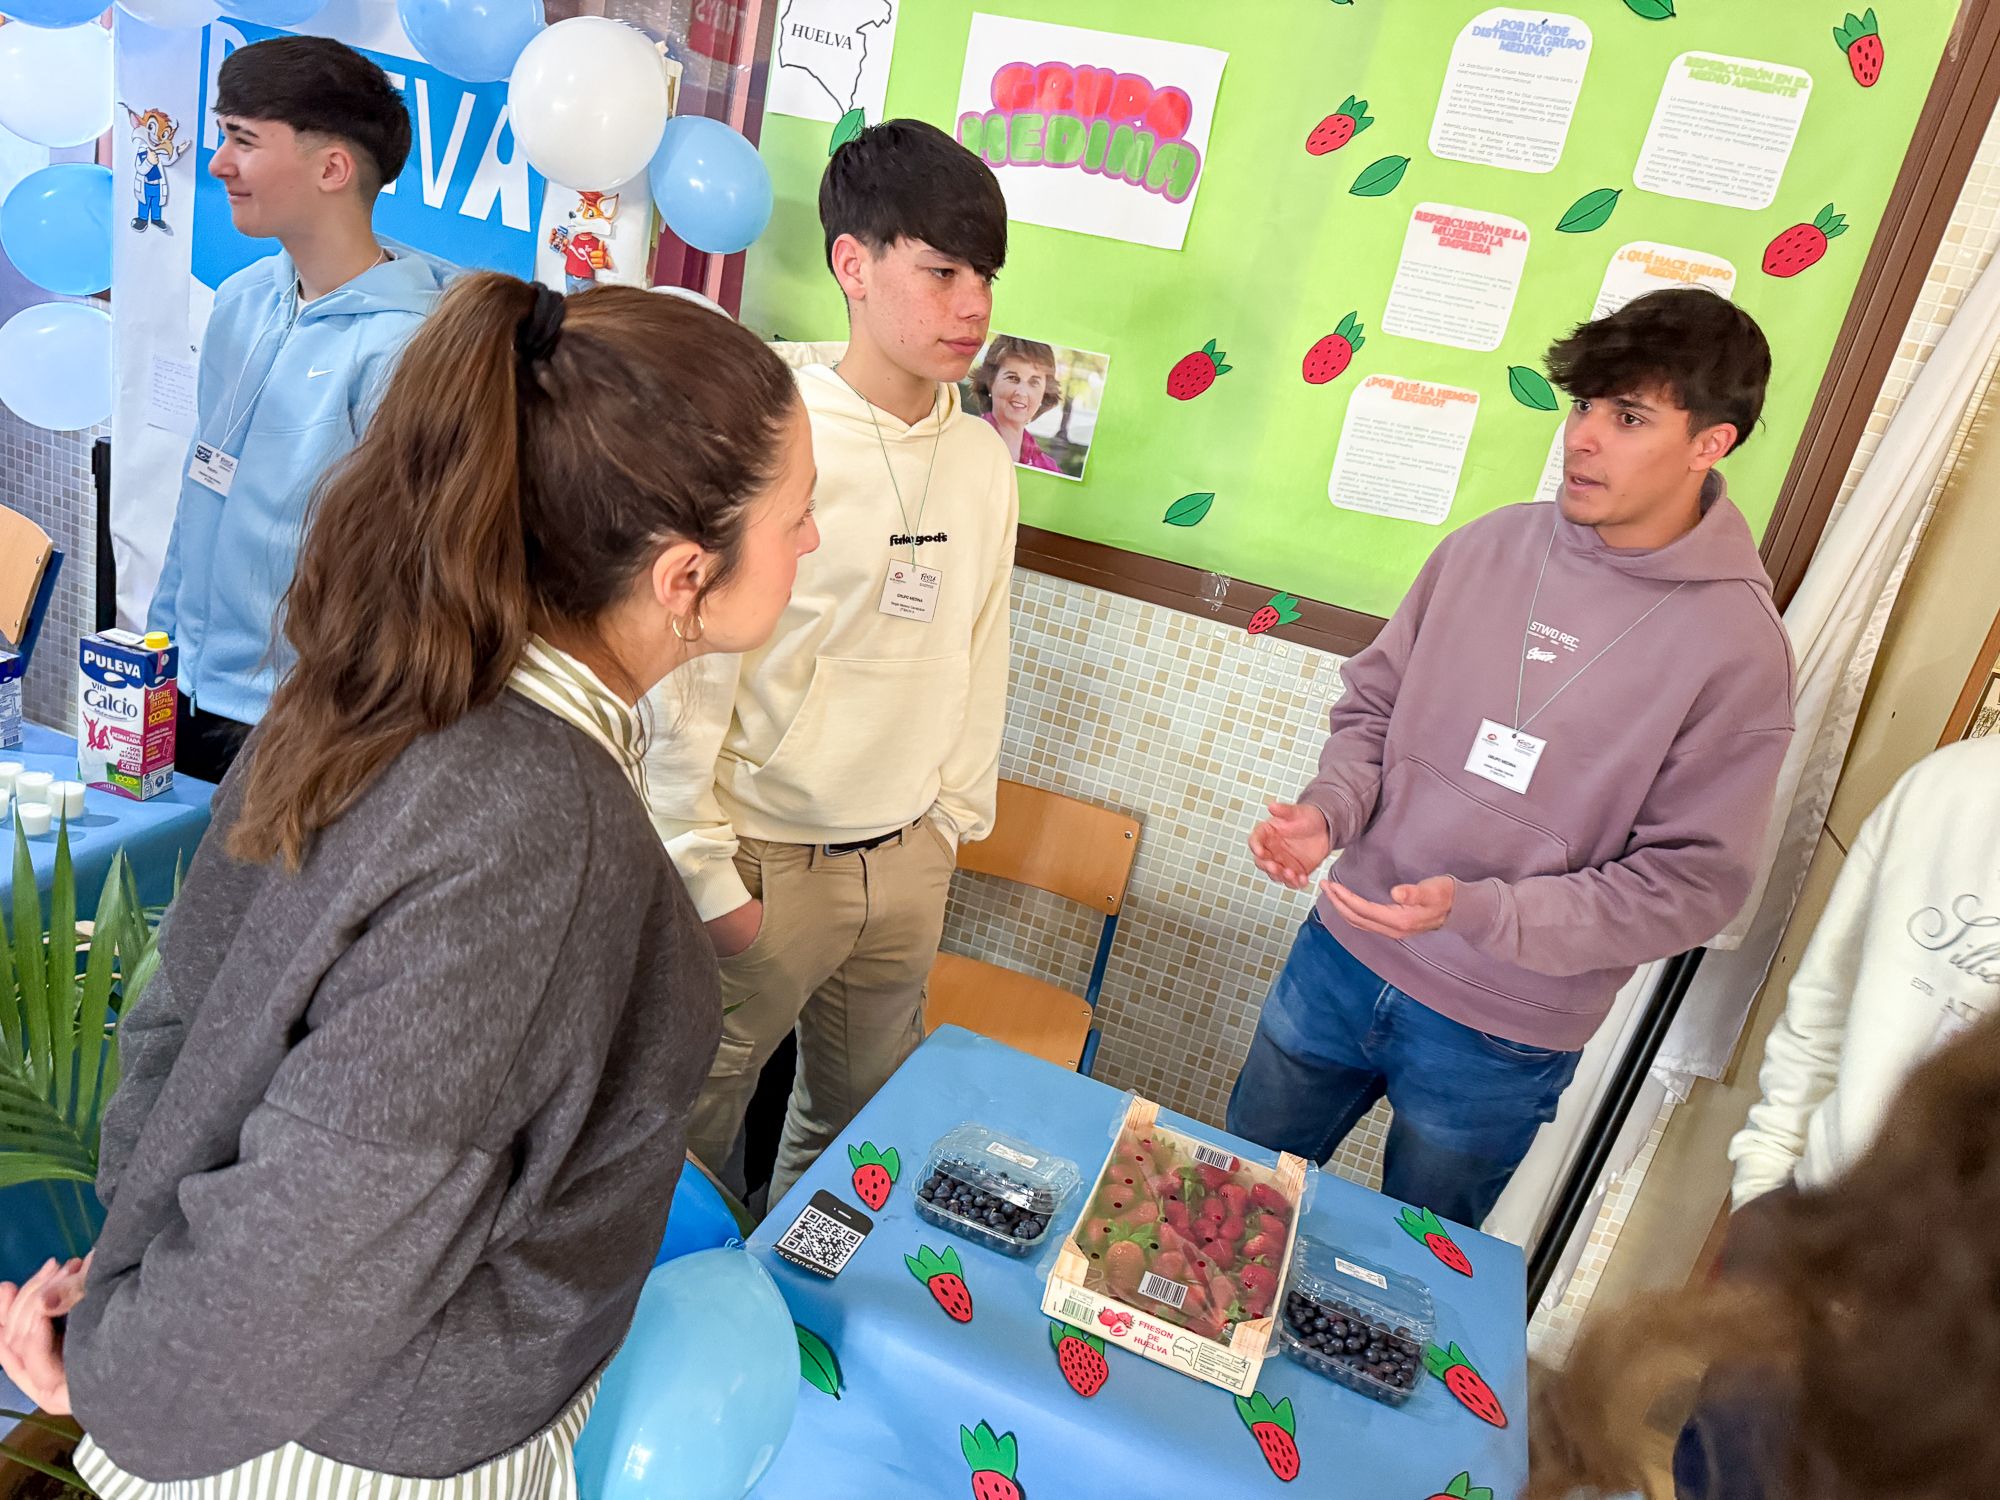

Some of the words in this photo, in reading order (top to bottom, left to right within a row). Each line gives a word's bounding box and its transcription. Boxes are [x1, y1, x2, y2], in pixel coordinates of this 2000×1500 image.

[791, 23, 853, 50] HUELVA
[1471, 26, 1542, 45] DISTRIBUYE
[1543, 35, 1586, 50] GRUPO
[1498, 41, 1553, 57] MEDINA?
[991, 61, 1193, 141] GRUPO
[1414, 210, 1494, 235] REPERCUSIÓN
[1495, 226, 1512, 238] DE
[1512, 229, 1527, 242] LA
[1432, 225, 1471, 241] MUJER
[1472, 231, 1488, 244] EN
[1489, 234, 1504, 247] LA
[1438, 236, 1492, 256] EMPRESA
[1627, 249, 1653, 264] QUÉ
[1653, 254, 1688, 271] HACE
[1688, 262, 1732, 281] GRUPO
[1365, 376, 1394, 389] ¿POR
[1420, 386, 1437, 398] LA
[1437, 388, 1479, 404] HEMOS
[1530, 621, 1560, 639] STWD
[83, 649, 141, 679] PULEVA
[91, 681, 107, 692] Vita
[83, 688, 138, 718] Calcio
[1138, 1320, 1174, 1340] FRESON
[1147, 1333, 1160, 1343] DE
[1133, 1336, 1168, 1356] HUELVA
